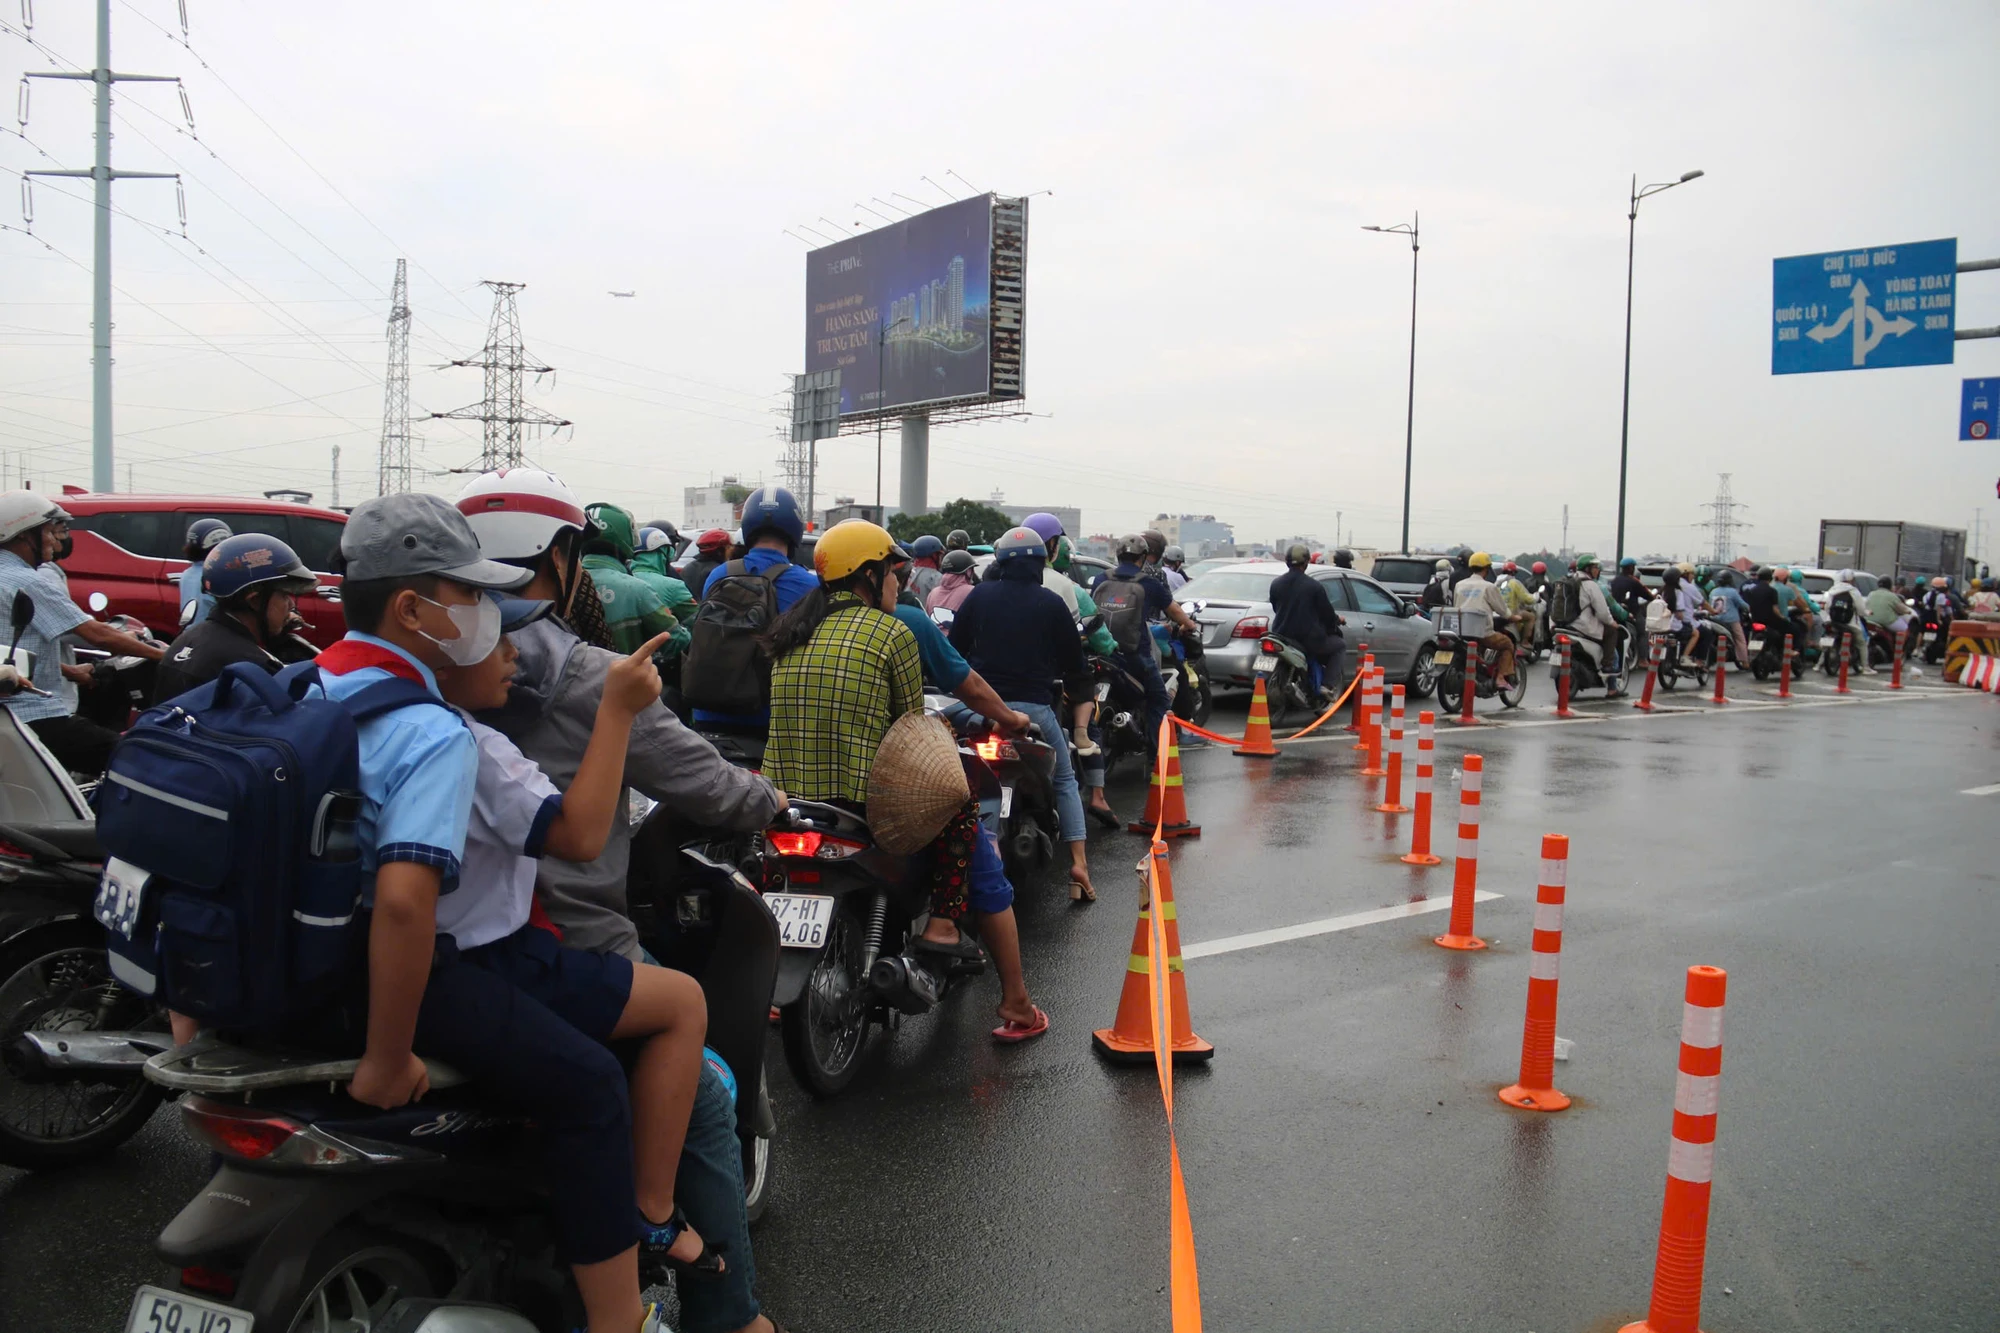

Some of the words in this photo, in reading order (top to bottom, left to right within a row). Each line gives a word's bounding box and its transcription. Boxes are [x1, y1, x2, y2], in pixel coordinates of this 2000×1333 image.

[1886, 276, 1916, 293] VÒNG
[1920, 274, 1951, 290] XOAY
[1885, 295, 1916, 312] HÀNG
[1920, 294, 1951, 310] XANH
[770, 898, 820, 920] 67-H1
[778, 921, 822, 944] 4.06
[207, 1191, 251, 1207] HONDA
